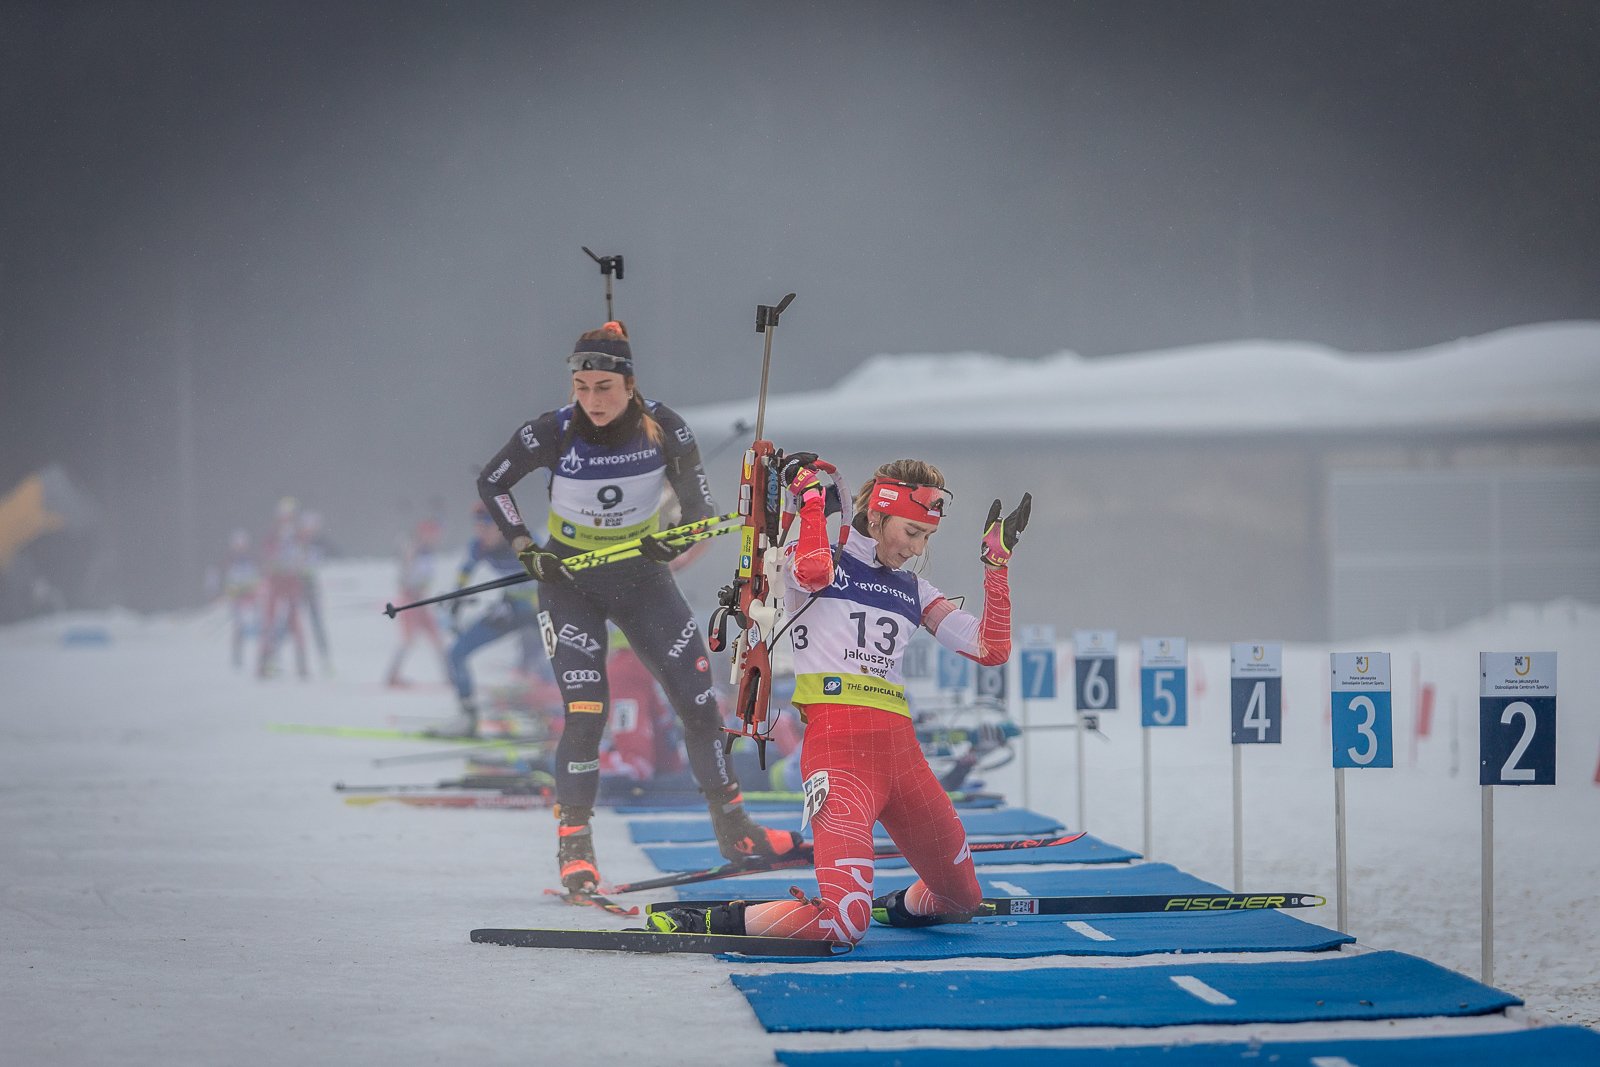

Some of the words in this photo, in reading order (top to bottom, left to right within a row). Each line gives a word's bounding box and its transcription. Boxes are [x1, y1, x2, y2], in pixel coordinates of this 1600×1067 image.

[589, 448, 657, 466] KRYOSYSTEM
[597, 484, 624, 511] 9
[558, 623, 601, 652] EA7
[849, 611, 899, 656] 13
[847, 683, 862, 691] THE
[863, 685, 895, 696] OFFICIAL
[1029, 653, 1049, 697] 7
[1083, 658, 1109, 709] 6
[1153, 670, 1177, 725] 5
[1243, 681, 1271, 741] 4
[1347, 695, 1378, 765] 3
[1500, 701, 1537, 781] 2
[1165, 896, 1285, 912] FISCHER
